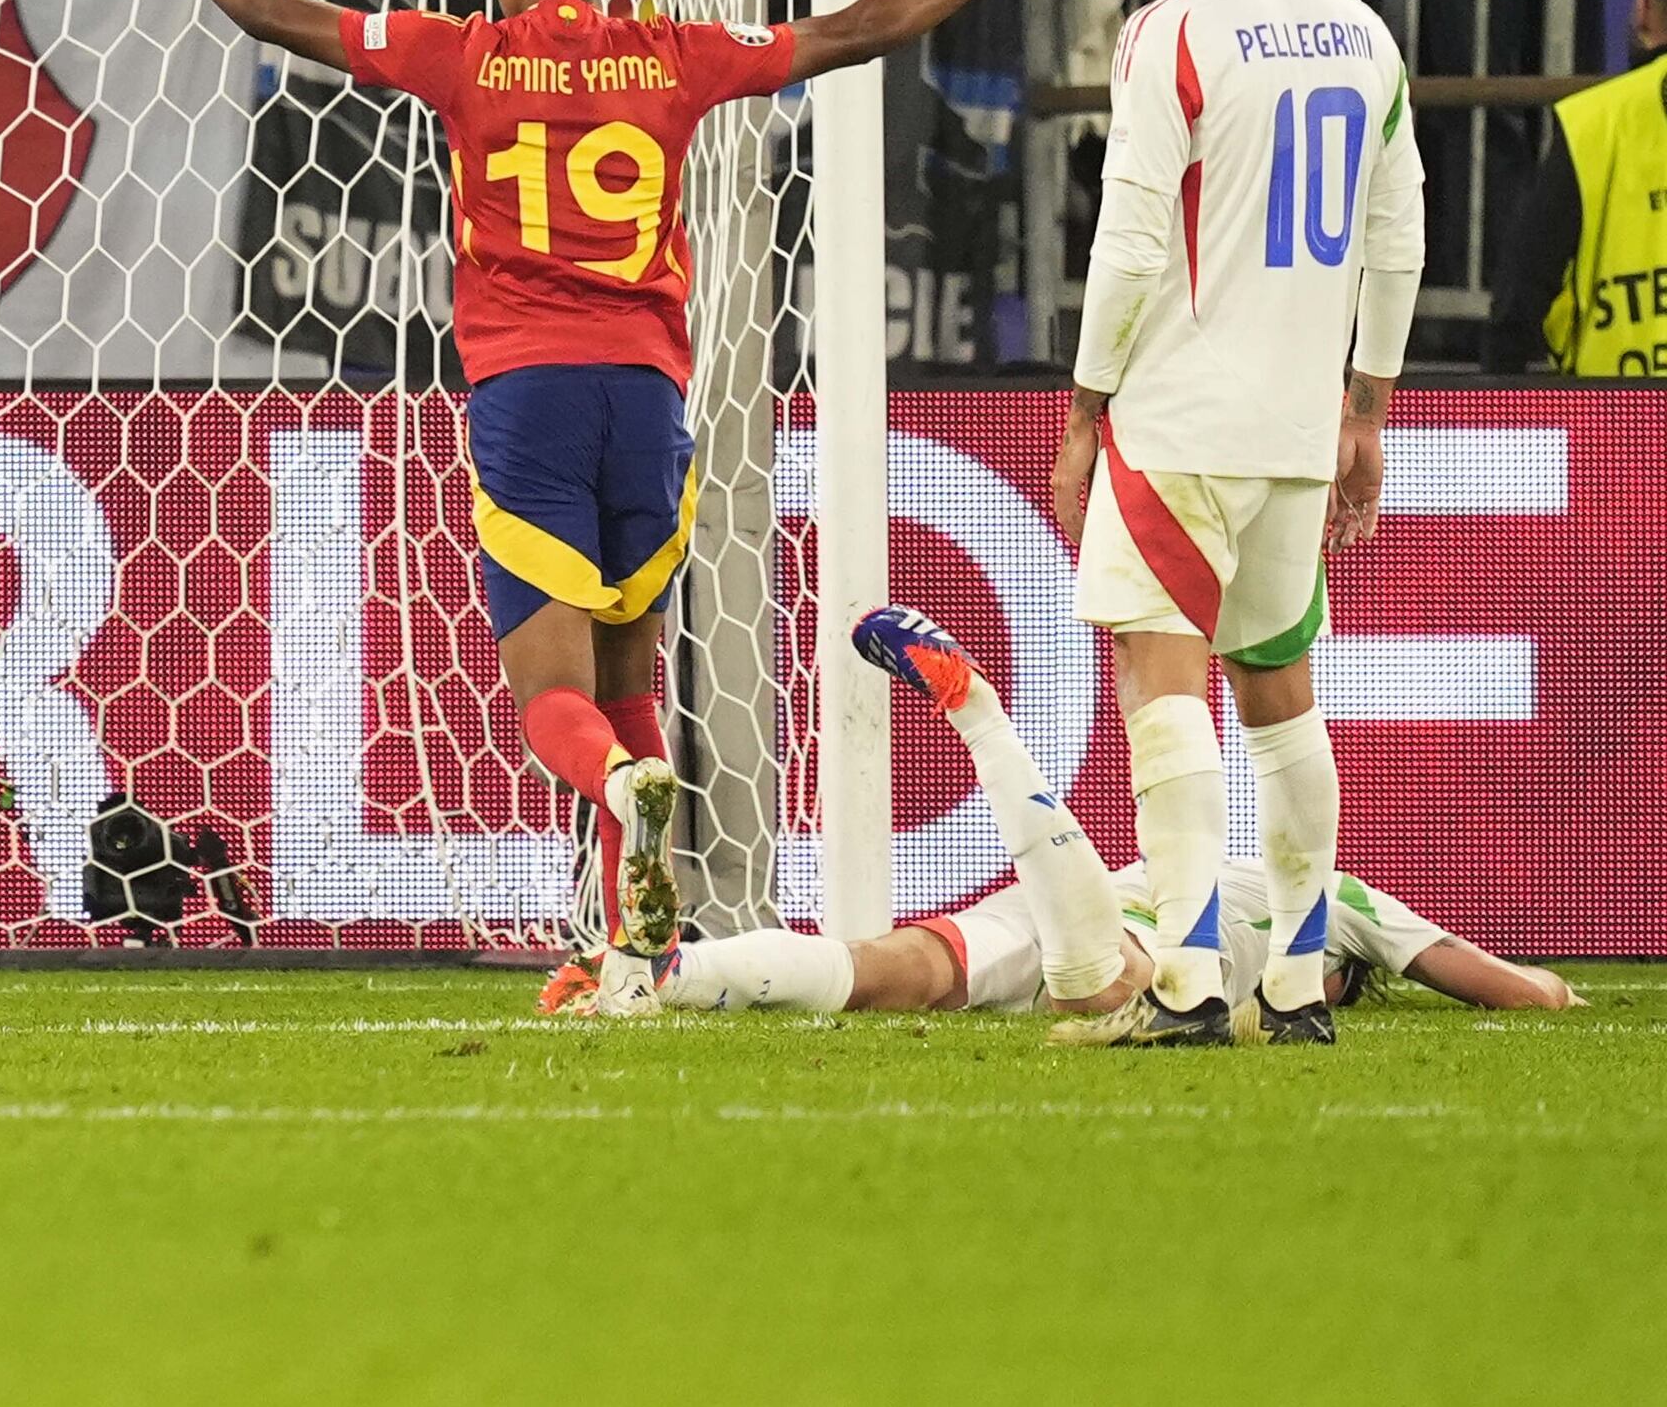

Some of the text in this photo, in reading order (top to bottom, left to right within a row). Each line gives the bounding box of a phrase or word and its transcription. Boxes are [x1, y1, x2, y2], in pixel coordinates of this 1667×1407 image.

[476, 50, 678, 95] LAMINE YAMAL
[1235, 21, 1373, 64] PELLEGRINI
[485, 119, 667, 285] 19
[1264, 86, 1368, 269] 10
[1594, 266, 1667, 330] STE
